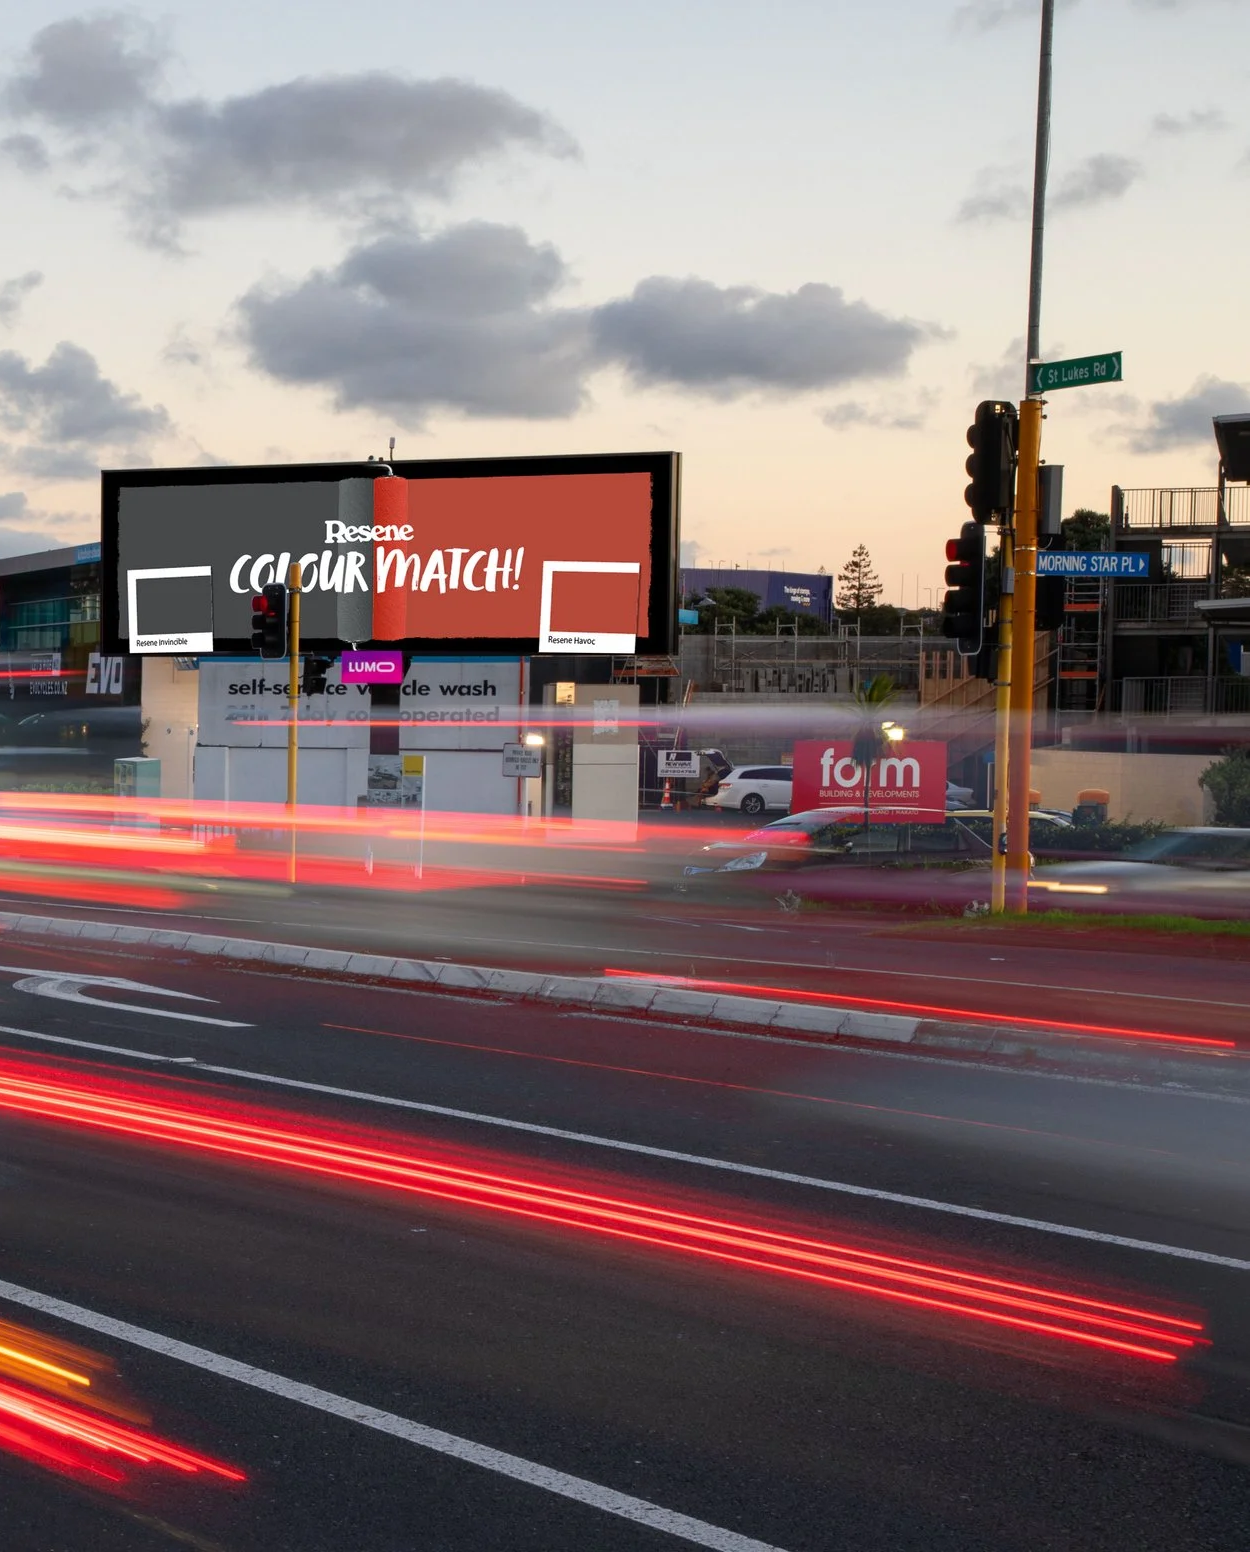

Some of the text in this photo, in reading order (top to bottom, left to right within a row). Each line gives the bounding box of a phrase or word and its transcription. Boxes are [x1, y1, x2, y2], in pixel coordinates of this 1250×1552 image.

[1048, 362, 1107, 384] St Lukes Rd
[324, 520, 414, 544] Resene
[229, 546, 525, 594] COLOUR MATCH!
[1038, 554, 1136, 573] MORNING STAR PL
[136, 637, 188, 647] Resene Invincible
[548, 635, 596, 646] Resene Havoc
[86, 652, 124, 695] EVO
[348, 661, 395, 673] LUMO
[439, 679, 497, 697] wash
[399, 705, 500, 727] operated
[820, 748, 920, 788] form
[819, 790, 853, 798] BUILDING
